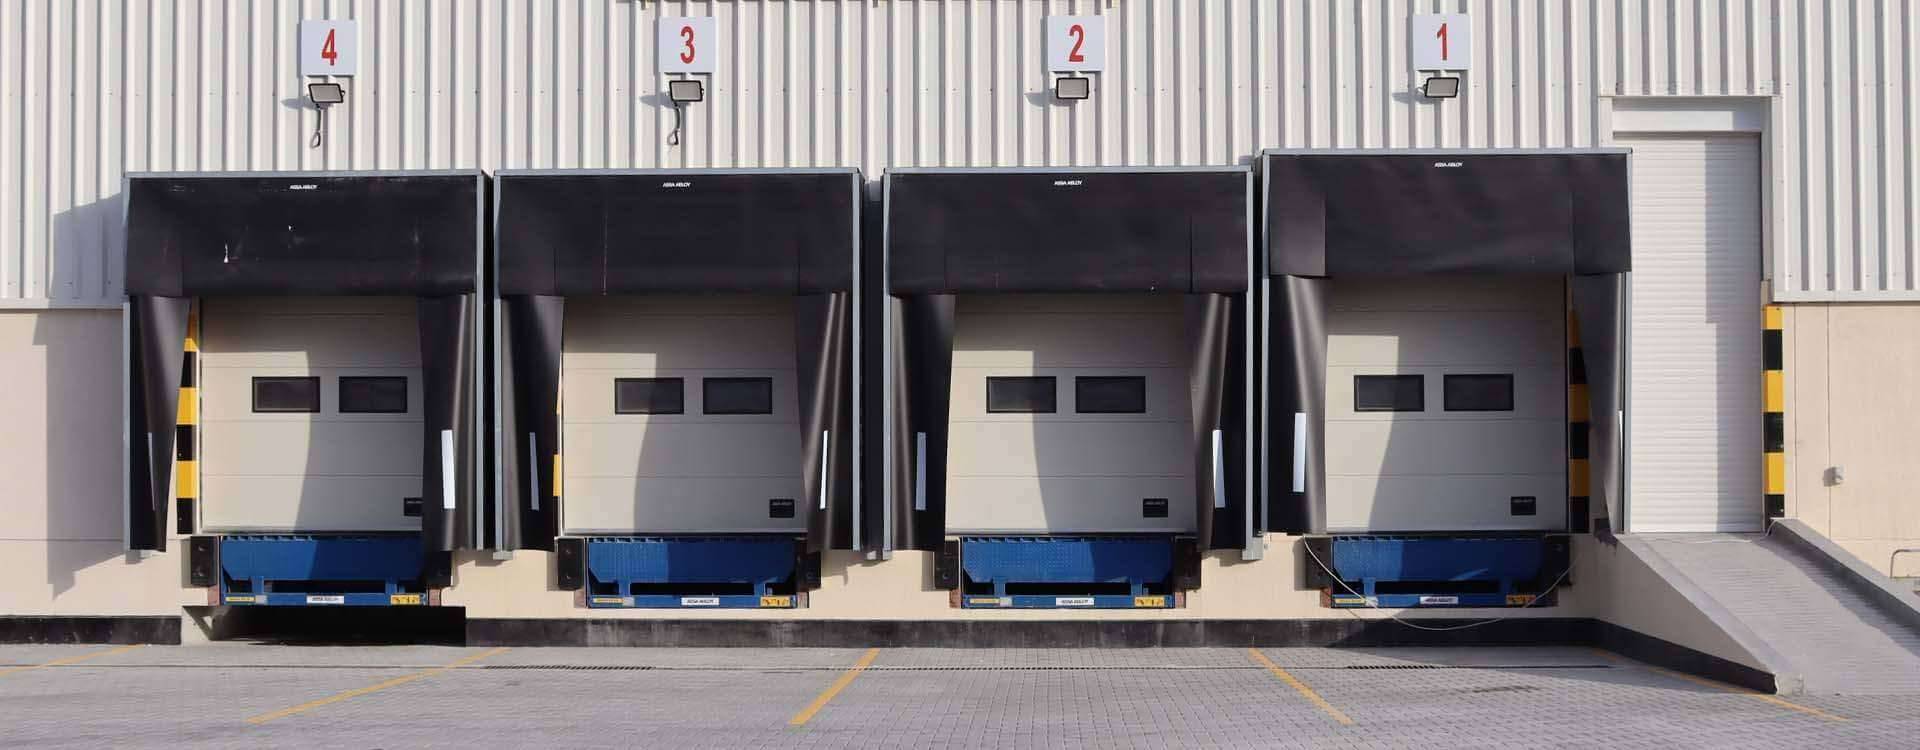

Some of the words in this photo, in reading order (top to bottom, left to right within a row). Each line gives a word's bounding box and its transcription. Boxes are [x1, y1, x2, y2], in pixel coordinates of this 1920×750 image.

[321, 28, 337, 66] 4
[680, 25, 695, 64] 3
[1069, 24, 1084, 62] 2
[1436, 23, 1447, 61] 1
